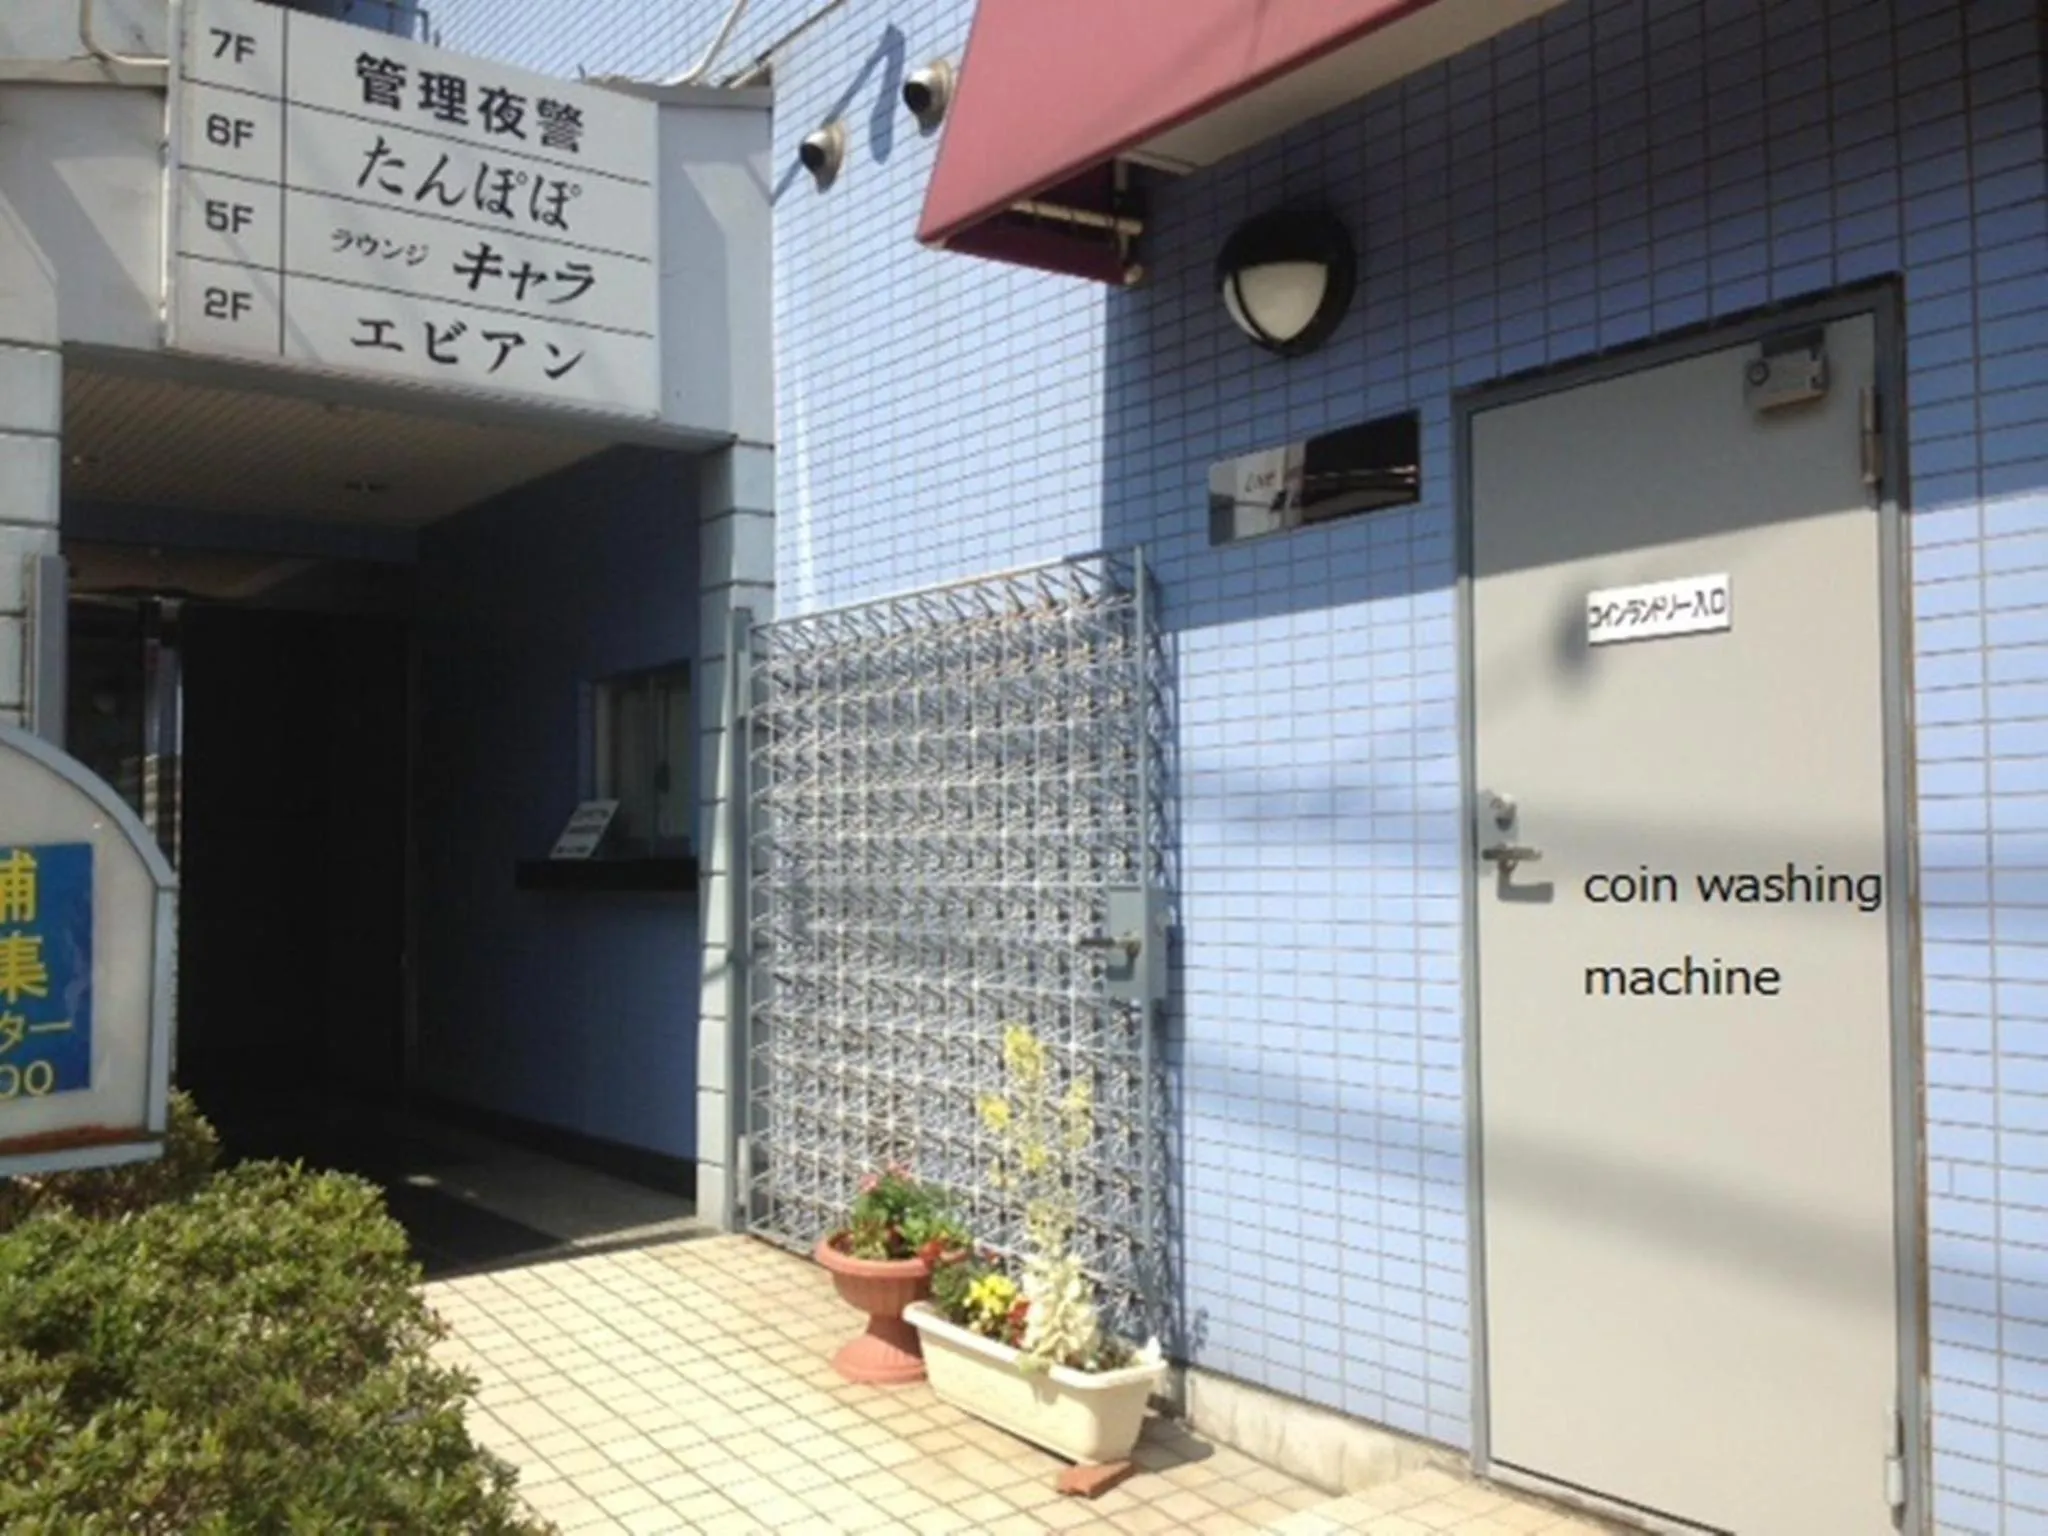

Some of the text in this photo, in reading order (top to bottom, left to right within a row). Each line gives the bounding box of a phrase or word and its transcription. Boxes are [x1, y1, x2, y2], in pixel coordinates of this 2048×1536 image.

[209, 28, 586, 154] 7F 管理夜警
[206, 113, 583, 232] 6F たんぽぽ
[204, 199, 597, 306] 5F ラウンジ キャラ
[203, 288, 587, 380] 2F エビアン
